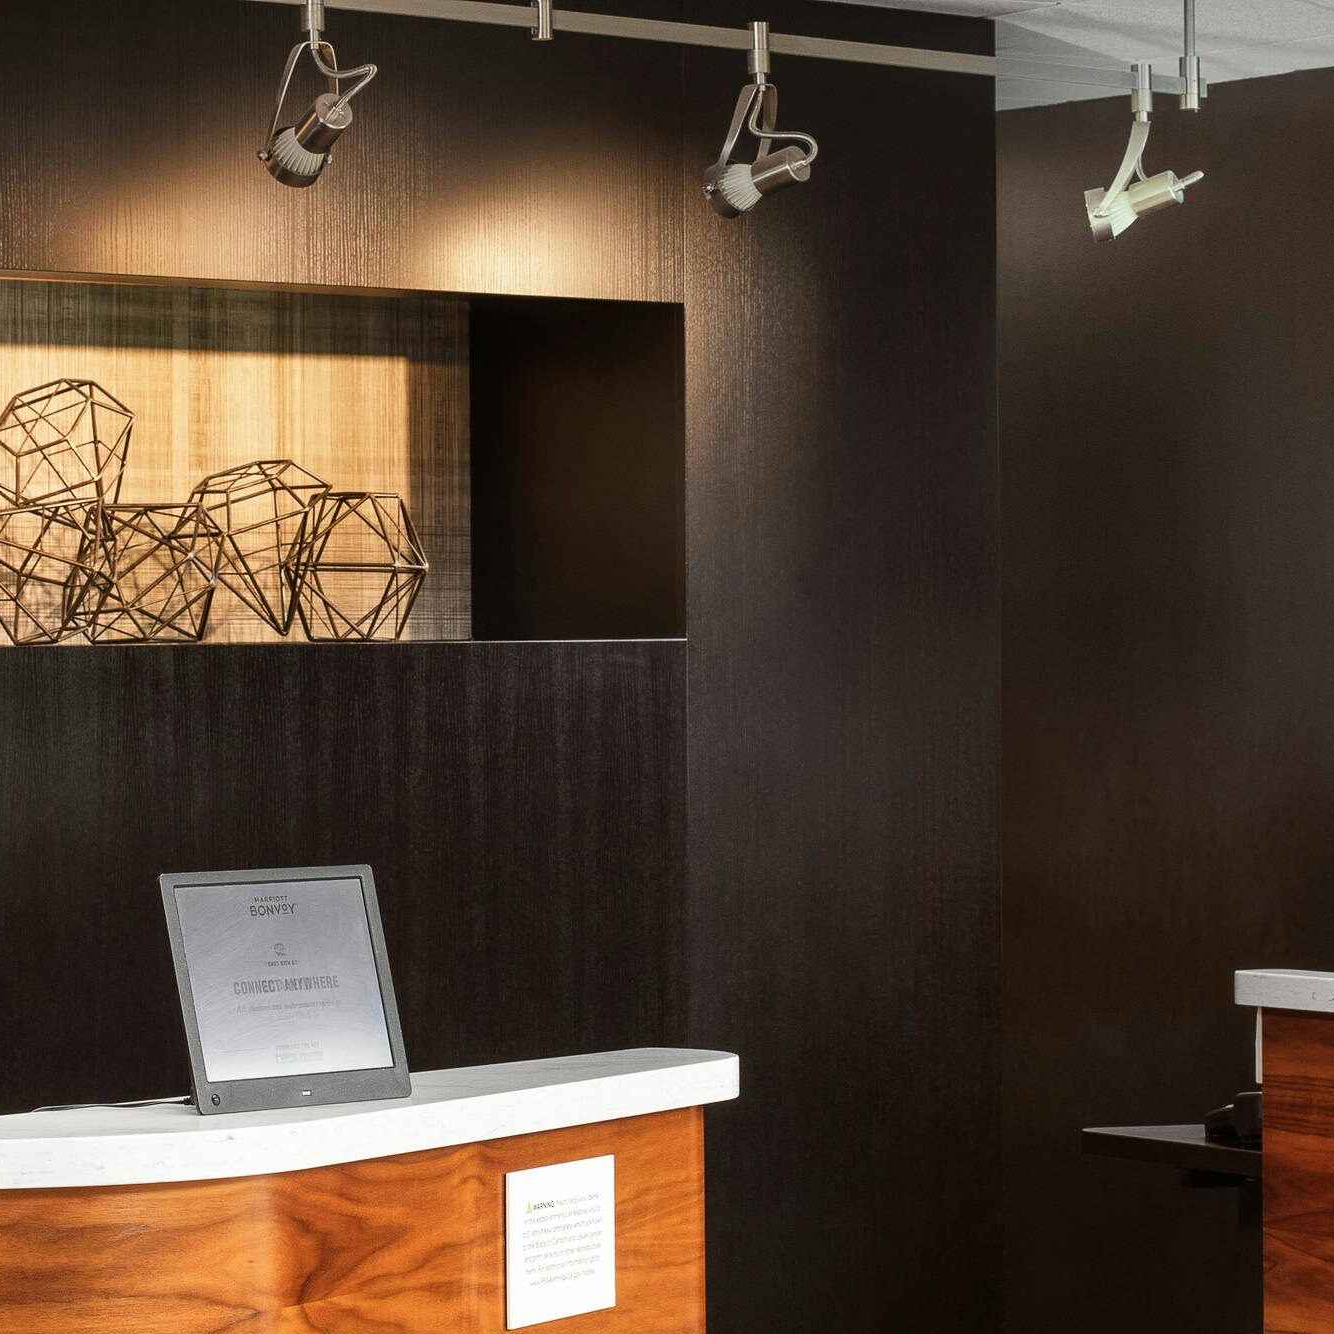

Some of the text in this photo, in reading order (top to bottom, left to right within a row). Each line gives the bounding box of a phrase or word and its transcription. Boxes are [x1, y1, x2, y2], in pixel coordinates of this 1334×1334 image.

[250, 903, 295, 916] BONVOY
[233, 975, 340, 995] CONNECT ANYWHERE
